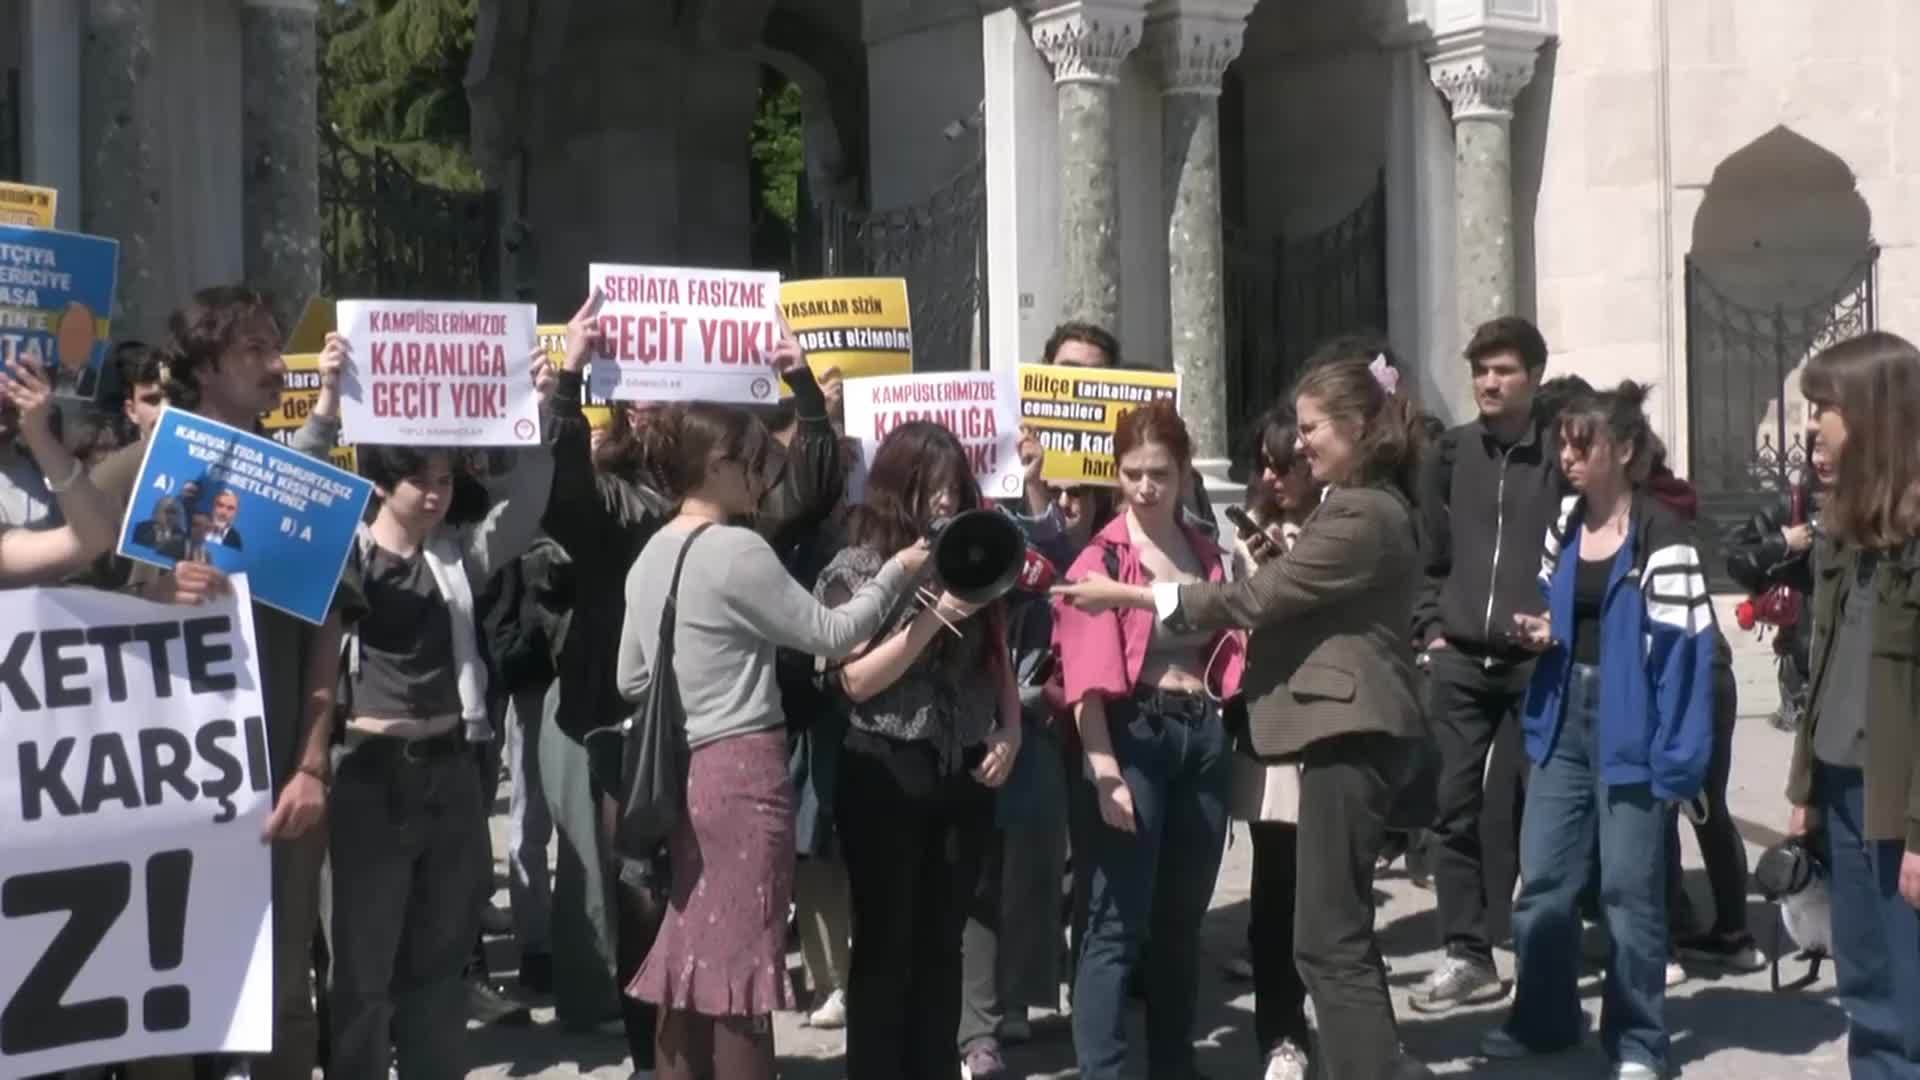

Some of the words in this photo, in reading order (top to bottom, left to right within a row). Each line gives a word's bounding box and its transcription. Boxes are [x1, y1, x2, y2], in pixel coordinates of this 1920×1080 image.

[370, 310, 507, 336] KAMPÜSLERİMİZDE
[599, 312, 687, 363] GEÇİT
[699, 318, 773, 365] YOK!
[371, 340, 507, 377] KARANLIĞA
[373, 378, 441, 420] GEÇİT
[451, 383, 507, 419] YOK!
[1024, 373, 1069, 398] Bütçe
[153, 474, 175, 492] A)
[299, 526, 312, 541] A
[18, 716, 270, 823] KARŞI
[0, 849, 193, 1056] Z!
